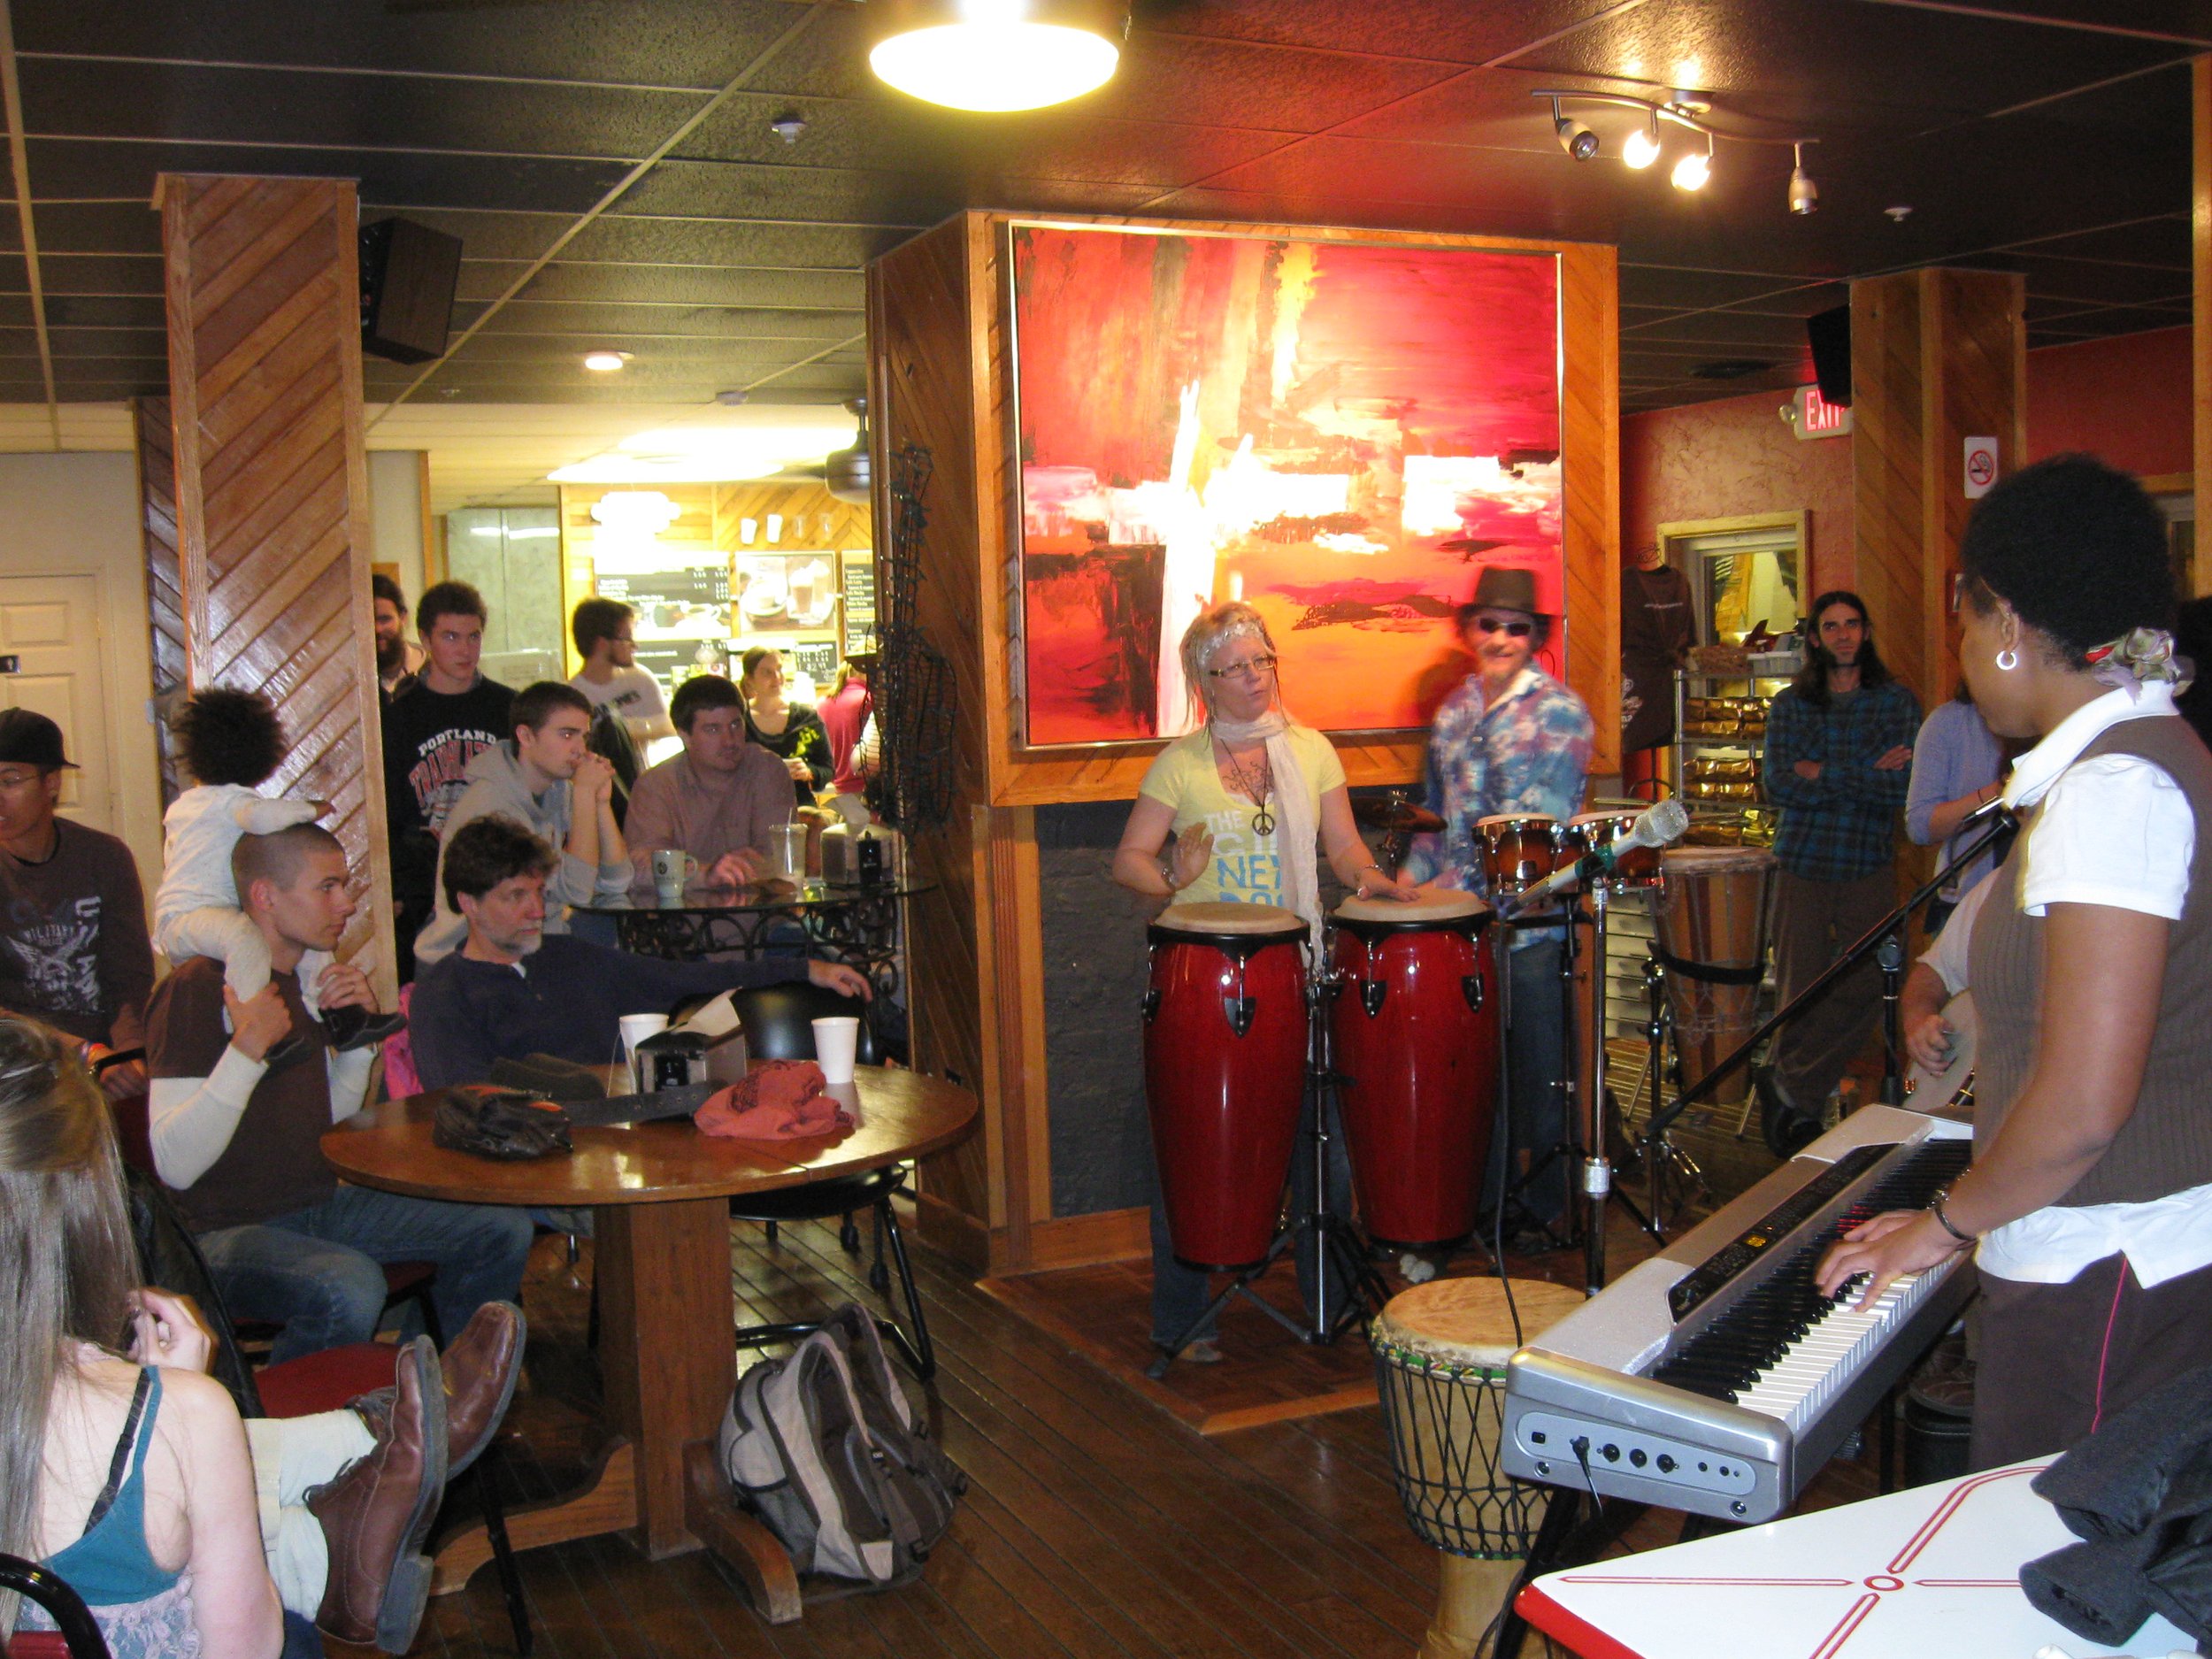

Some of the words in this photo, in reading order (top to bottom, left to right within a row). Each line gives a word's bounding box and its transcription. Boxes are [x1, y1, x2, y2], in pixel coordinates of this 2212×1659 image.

[1806, 389, 1845, 432] EXIT
[418, 728, 496, 757] PORTLAND
[1203, 810, 1247, 833] THE
